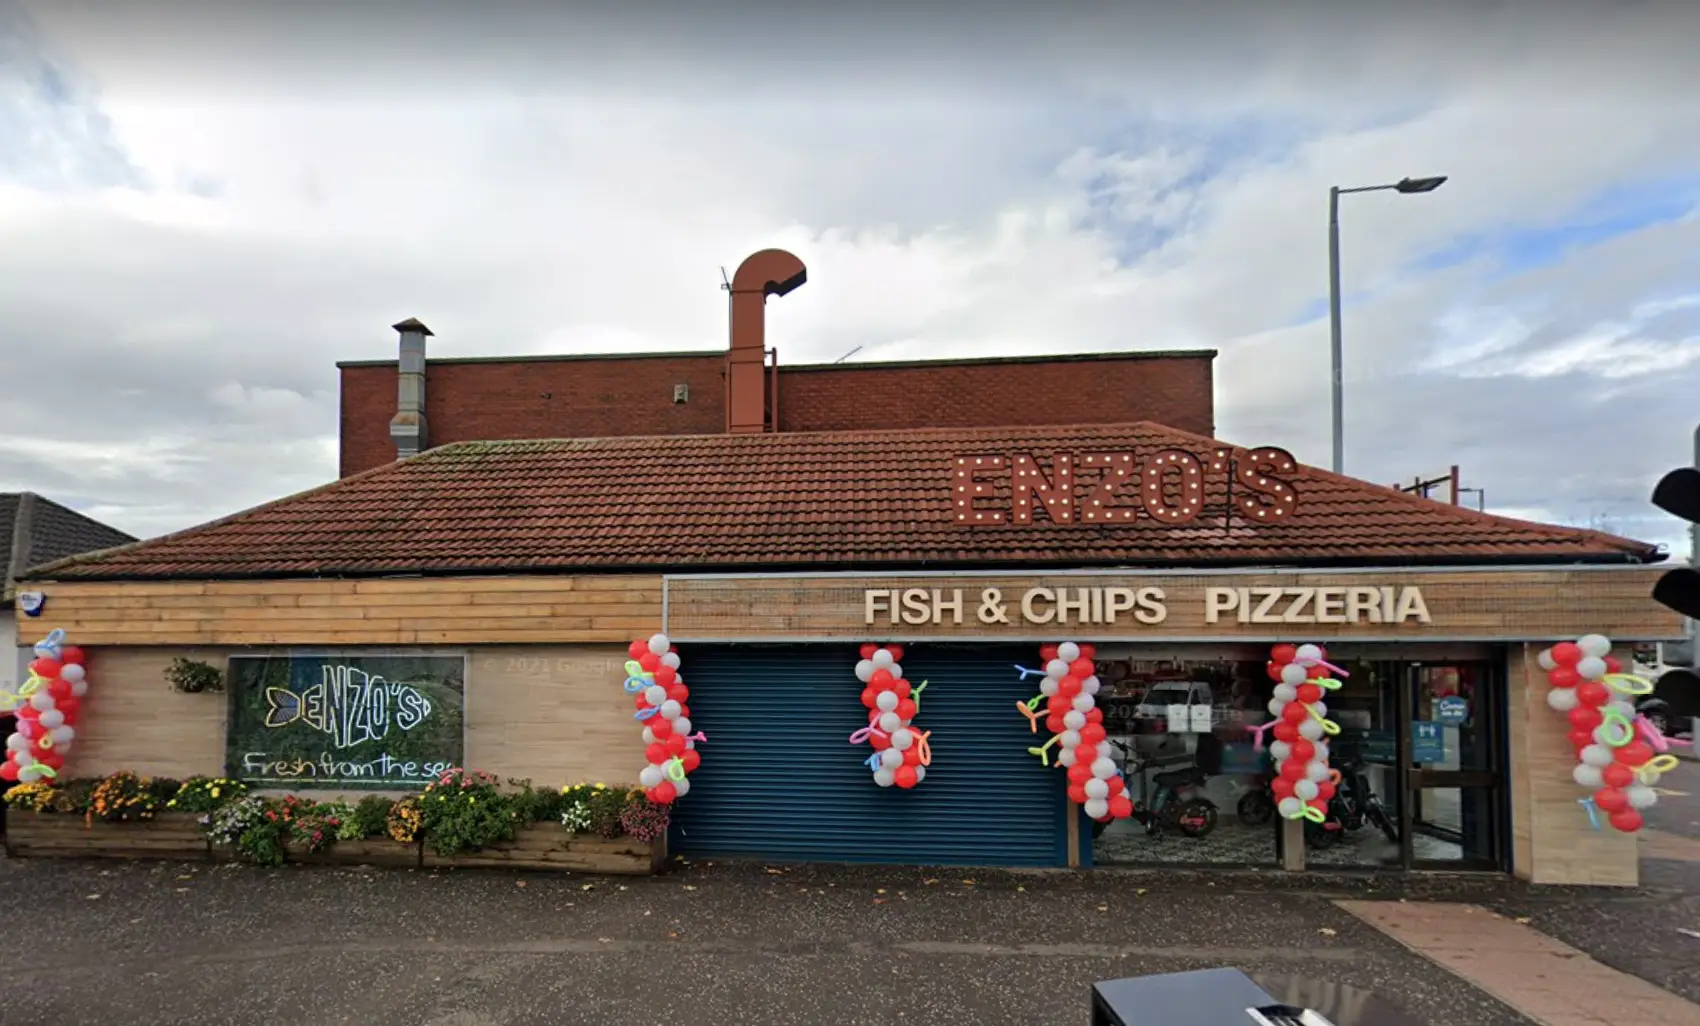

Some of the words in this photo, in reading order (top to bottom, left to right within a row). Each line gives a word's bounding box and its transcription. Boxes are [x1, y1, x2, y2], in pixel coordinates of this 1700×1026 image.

[952, 446, 1298, 526] ENZO'S
[864, 588, 964, 625] FISH
[976, 588, 1010, 625] &
[1021, 586, 1168, 625] CHIPS
[1205, 586, 1433, 624] PIZZERIA
[302, 664, 423, 749] ENZO'S
[243, 751, 316, 777] Fresh
[319, 750, 374, 777] from
[371, 752, 419, 778] the
